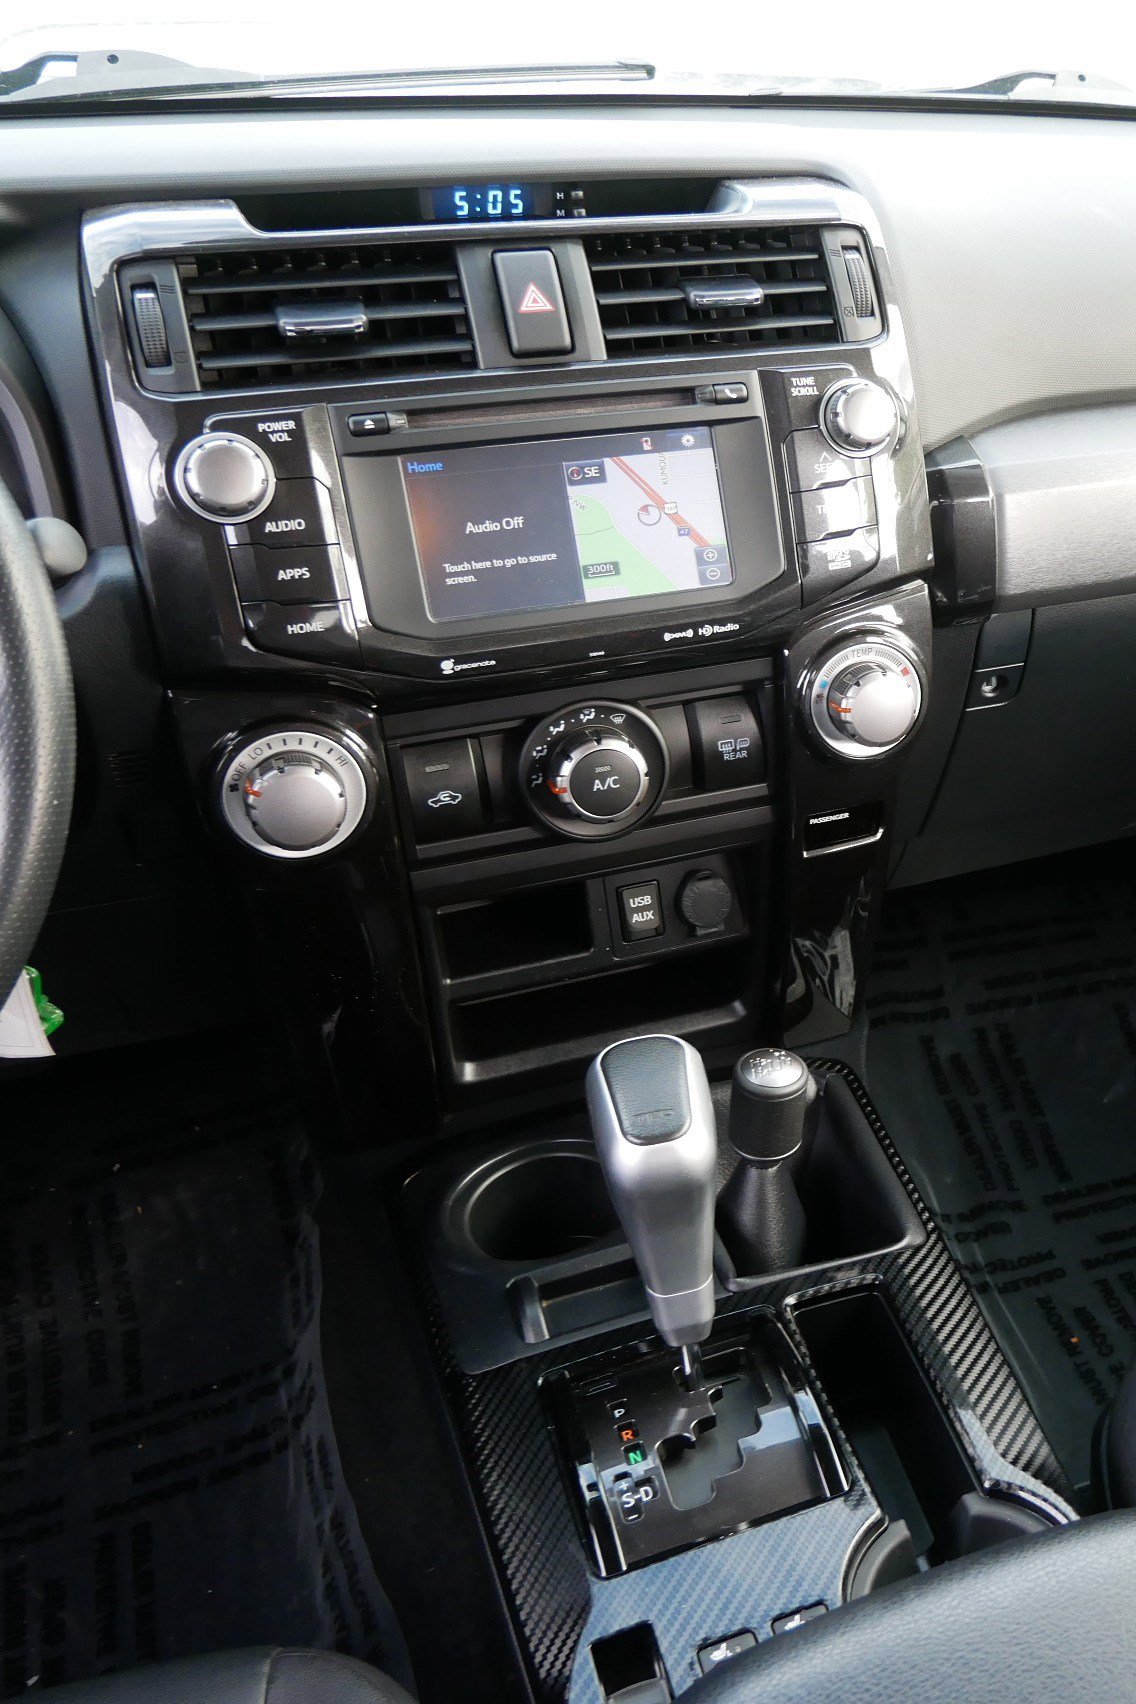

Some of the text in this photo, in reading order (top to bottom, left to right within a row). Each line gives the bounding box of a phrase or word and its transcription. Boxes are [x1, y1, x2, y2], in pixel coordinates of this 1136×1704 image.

[454, 189, 524, 216] 5:05
[556, 192, 564, 200] H
[556, 209, 565, 217] M
[790, 376, 816, 386] TUNE
[790, 386, 819, 397] SCROLL
[257, 420, 296, 433] POWER
[268, 432, 292, 443] VOL
[406, 461, 444, 474] Home
[583, 465, 600, 478] SE
[264, 518, 306, 533] AUDIO
[465, 515, 525, 534] Audio Off
[442, 552, 558, 573] Touch here to go to source
[586, 563, 615, 575] 300ft
[277, 567, 311, 582] APPS
[445, 574, 478, 586] screen.
[287, 621, 326, 635] HOME
[713, 622, 740, 634] Radio
[851, 647, 873, 659] TEMP
[453, 660, 497, 672] gracenote
[723, 750, 749, 761] REAR
[232, 746, 349, 782] OFF LO HI
[592, 775, 620, 792] A/C
[809, 812, 850, 825] PASSENGER
[629, 894, 652, 908] USB
[631, 910, 655, 923] AUX
[613, 1408, 626, 1418] P
[620, 1429, 635, 1441] R
[628, 1450, 643, 1464] N
